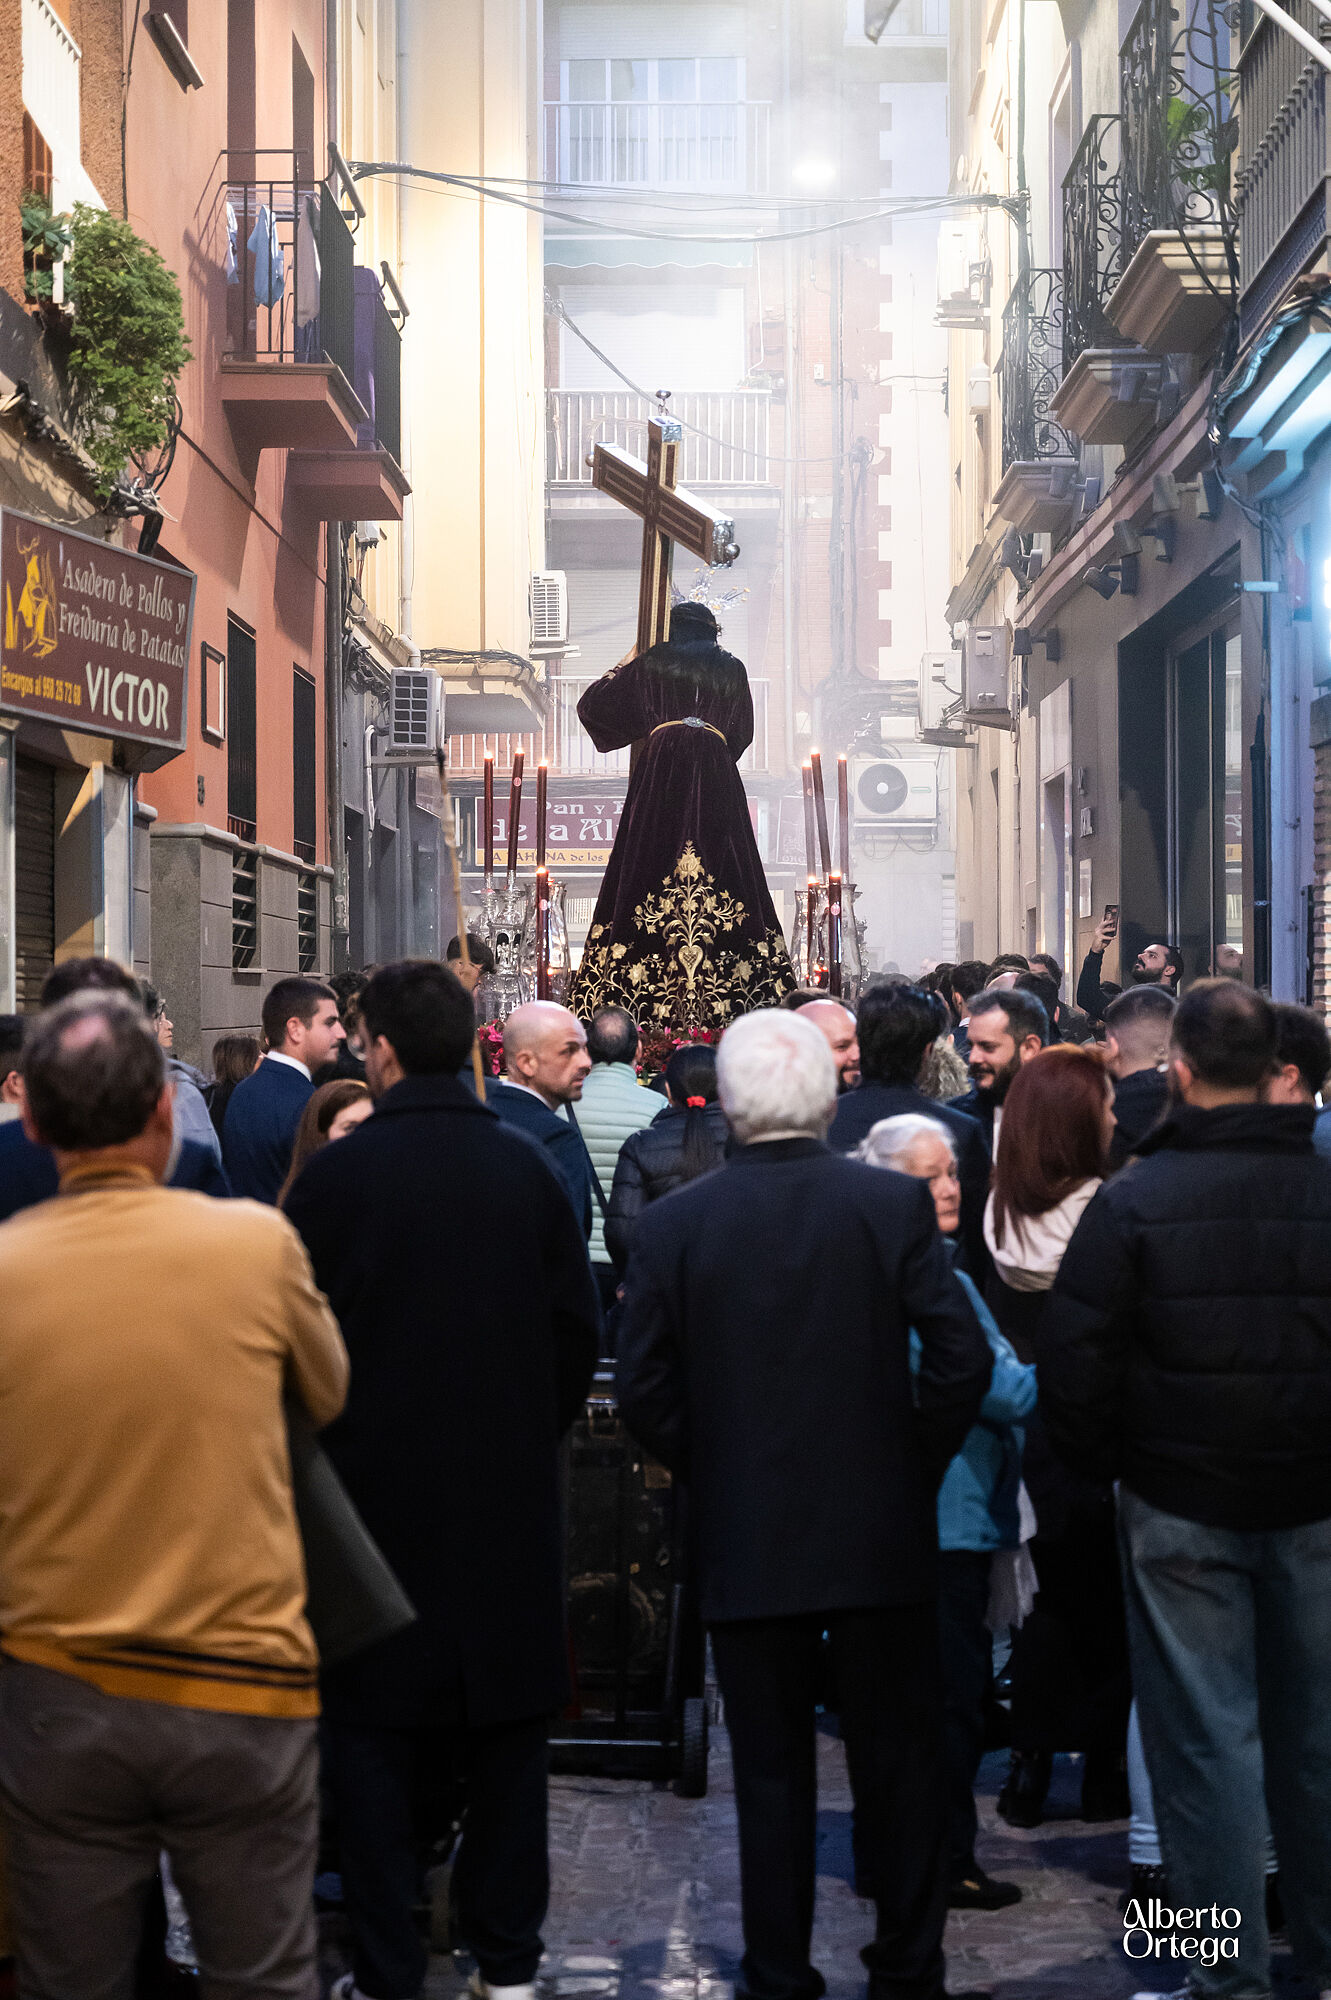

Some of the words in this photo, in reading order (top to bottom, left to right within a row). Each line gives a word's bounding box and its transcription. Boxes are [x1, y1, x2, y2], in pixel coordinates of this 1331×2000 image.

[62, 560, 116, 602] Asadero
[119, 572, 134, 608] de
[137, 575, 173, 621] Pollos
[175, 602, 186, 635] y
[122, 618, 136, 653] de
[140, 628, 184, 668] Patatas
[85, 661, 169, 731] VICTOR
[588, 852, 603, 862] los
